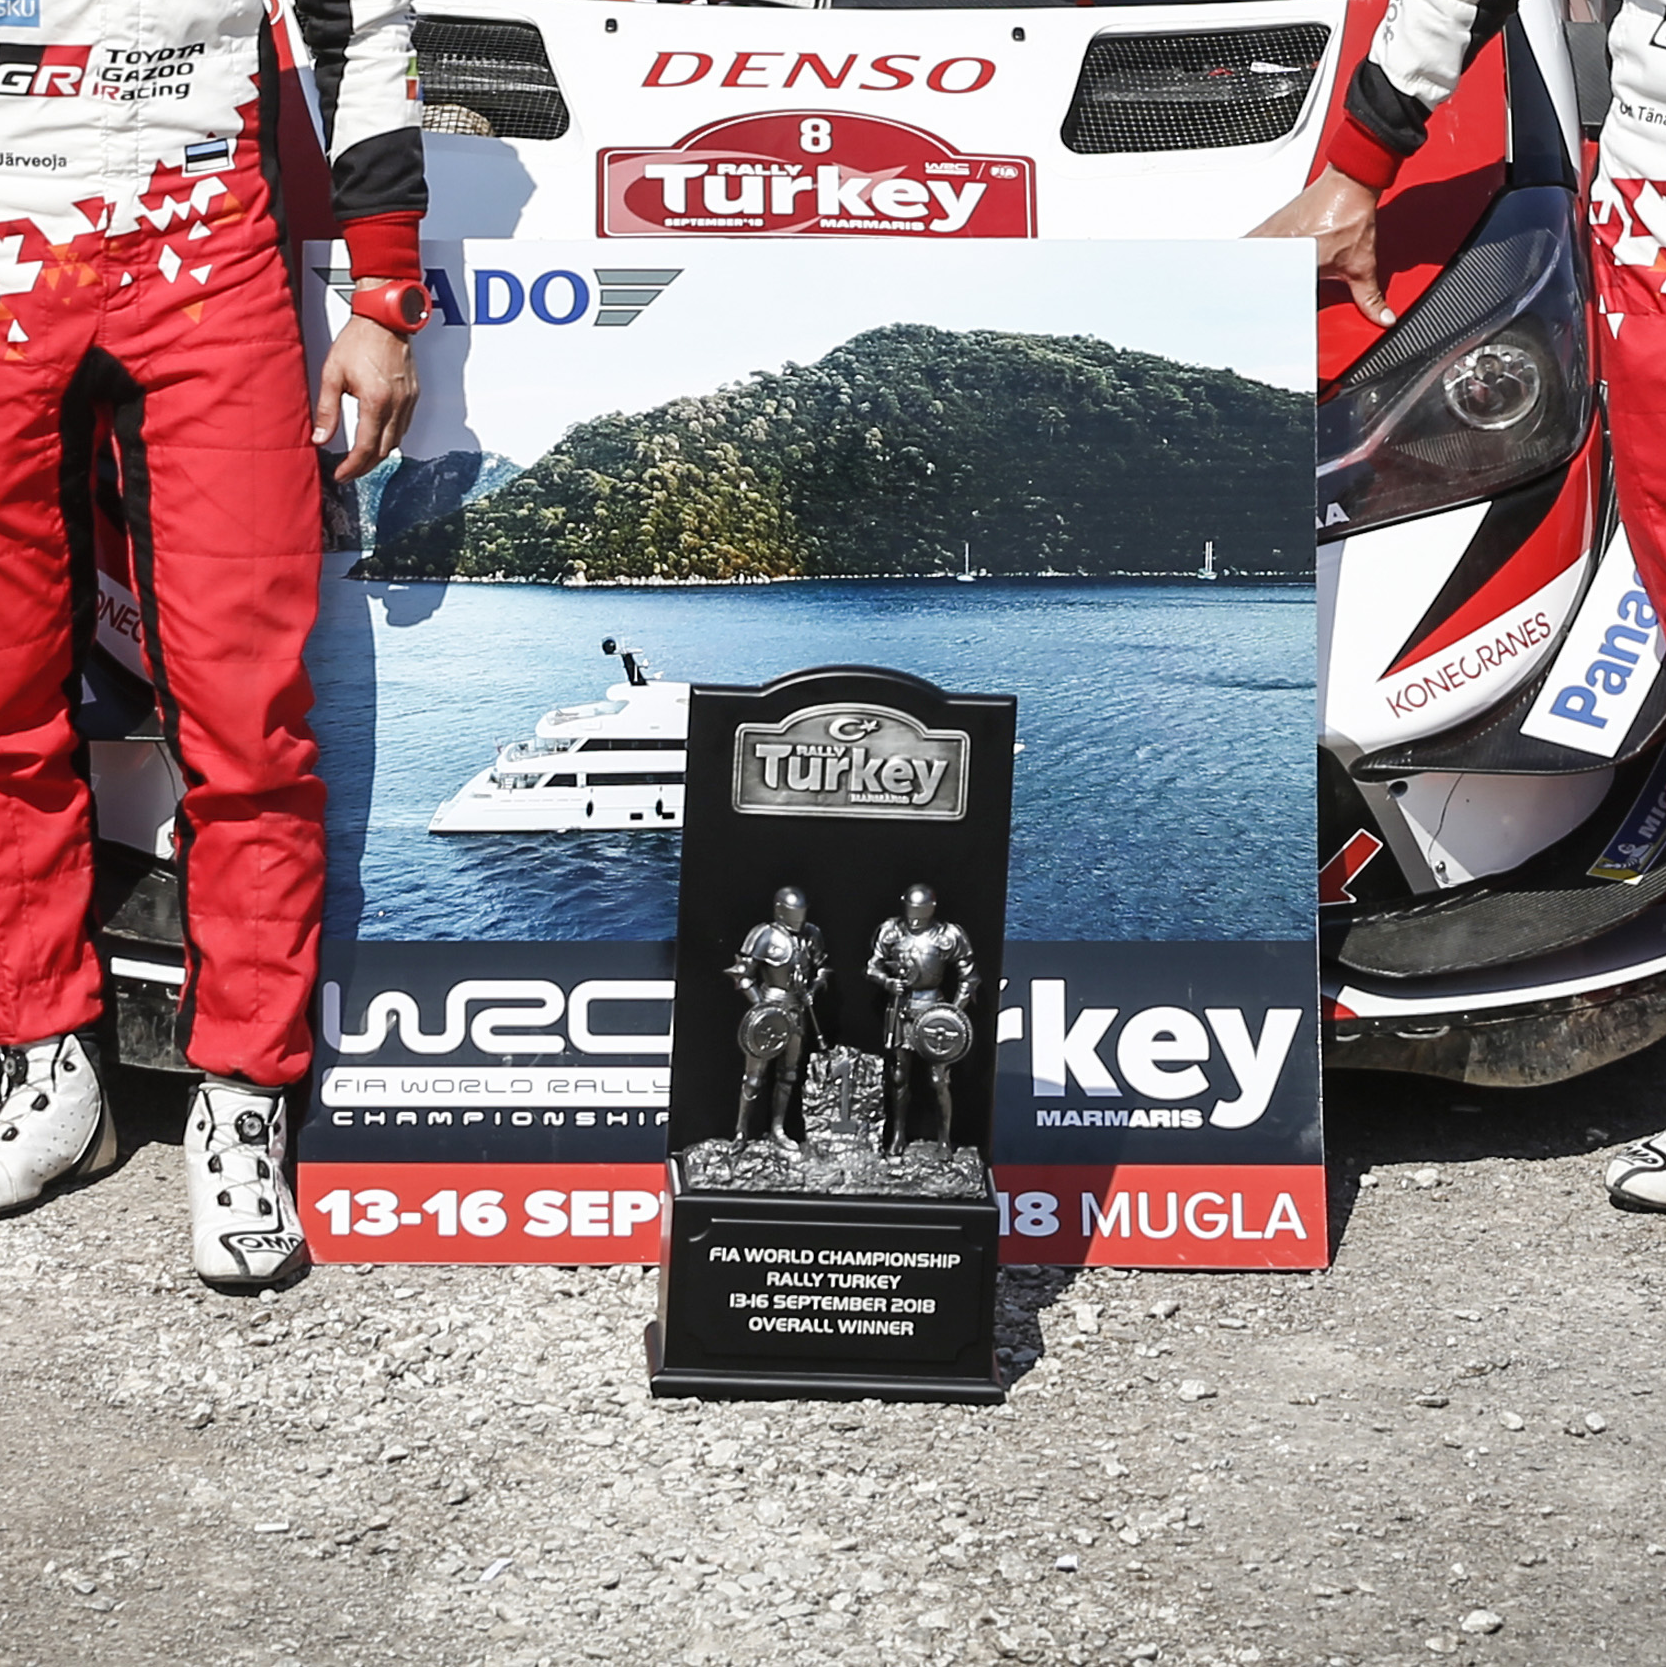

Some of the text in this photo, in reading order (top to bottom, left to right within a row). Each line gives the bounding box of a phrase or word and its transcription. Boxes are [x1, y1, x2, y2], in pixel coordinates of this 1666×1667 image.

[105, 43, 206, 64] TOYOTA
[100, 62, 195, 83] GAZOO
[640, 51, 997, 94] DENSO
[92, 82, 191, 102] Racing
[799, 116, 833, 154] 8
[717, 163, 803, 177] RALLY
[643, 164, 989, 233] Turkey
[819, 218, 926, 232] MARMARIS
[425, 267, 591, 328] ADO
[1385, 610, 1552, 719] KONECRANES
[755, 744, 950, 807] Turkey
[333, 1077, 393, 1095] FIA
[402, 1077, 535, 1096] WORLD
[1035, 1108, 1205, 1129] MARMARIS
[314, 1188, 515, 1239] 13-16
[1082, 1189, 1308, 1240] MUGLA
[709, 1247, 961, 1270] FIA WORLD CHAMPIONSHIP
[766, 1272, 902, 1291] RALLY TURKEY
[729, 1293, 936, 1315] 13-16 SEPTEMBER 2018
[748, 1316, 915, 1337] OVERALL WINNER
